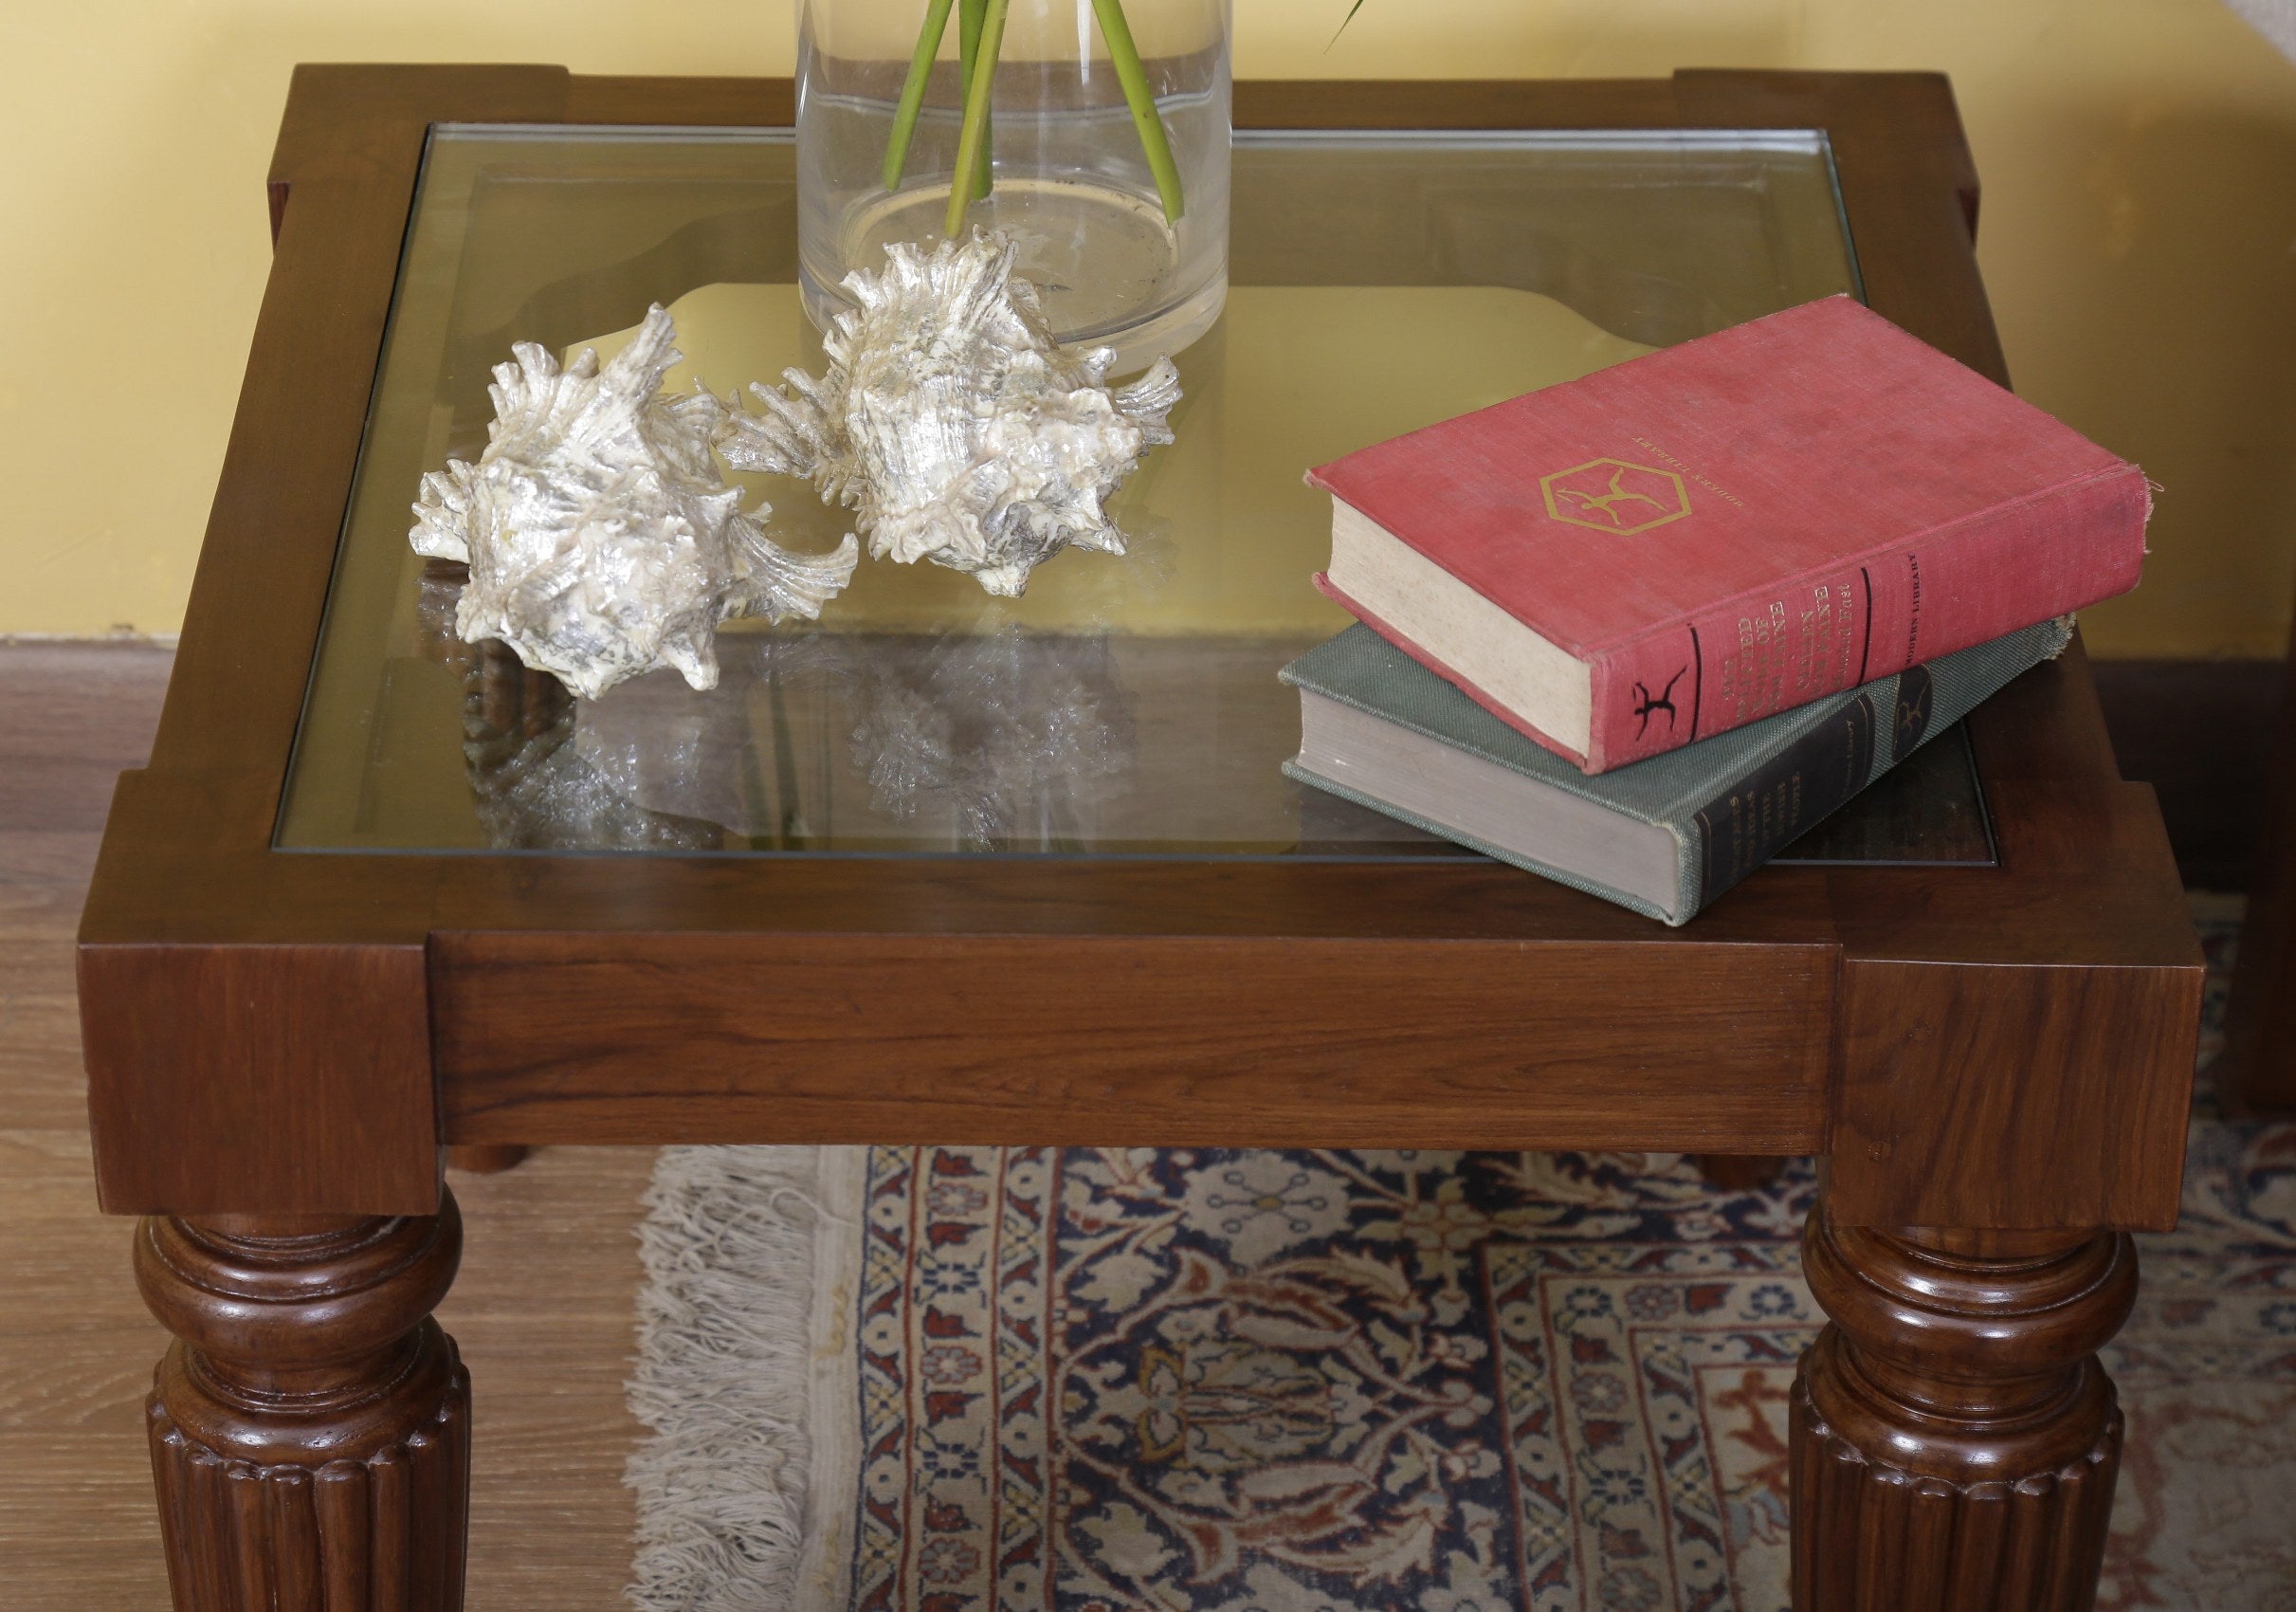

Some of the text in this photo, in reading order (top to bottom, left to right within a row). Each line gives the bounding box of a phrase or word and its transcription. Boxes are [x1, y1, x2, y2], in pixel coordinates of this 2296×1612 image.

[1755, 616, 1769, 645] OF
[1770, 601, 1786, 669] PAINE
[1814, 585, 1831, 652] PAINE
[1904, 554, 1921, 666] MODERN LIBRARY
